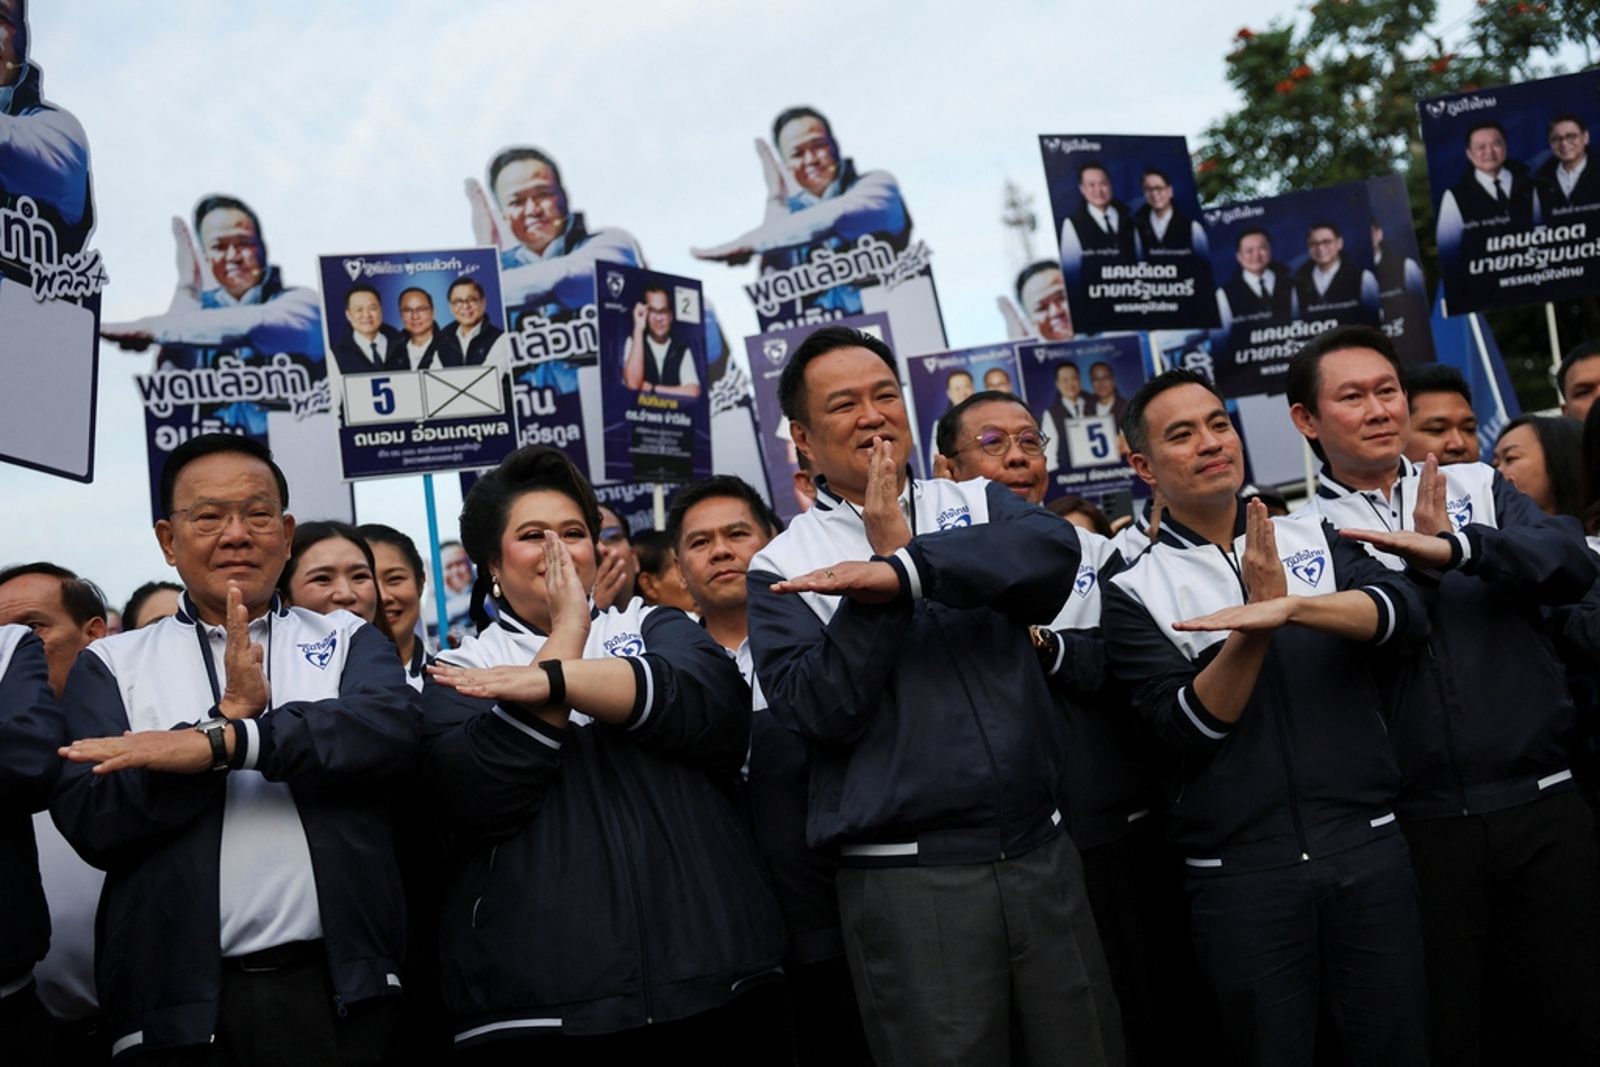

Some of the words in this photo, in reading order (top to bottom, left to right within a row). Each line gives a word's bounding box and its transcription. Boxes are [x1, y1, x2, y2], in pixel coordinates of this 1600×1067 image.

[1486, 222, 1586, 252] แคนดิเดต
[745, 238, 893, 313] พูดแล้วทำ
[1101, 261, 1178, 279] แคนดิเดต
[1088, 278, 1195, 301] นายกรัฐมนตรี
[136, 357, 306, 413] พูดแล้วทำ
[371, 377, 396, 415] 5
[354, 430, 406, 447] ถนอม
[411, 419, 509, 442] อ่อนเกตุพล
[1087, 423, 1110, 458] 5
